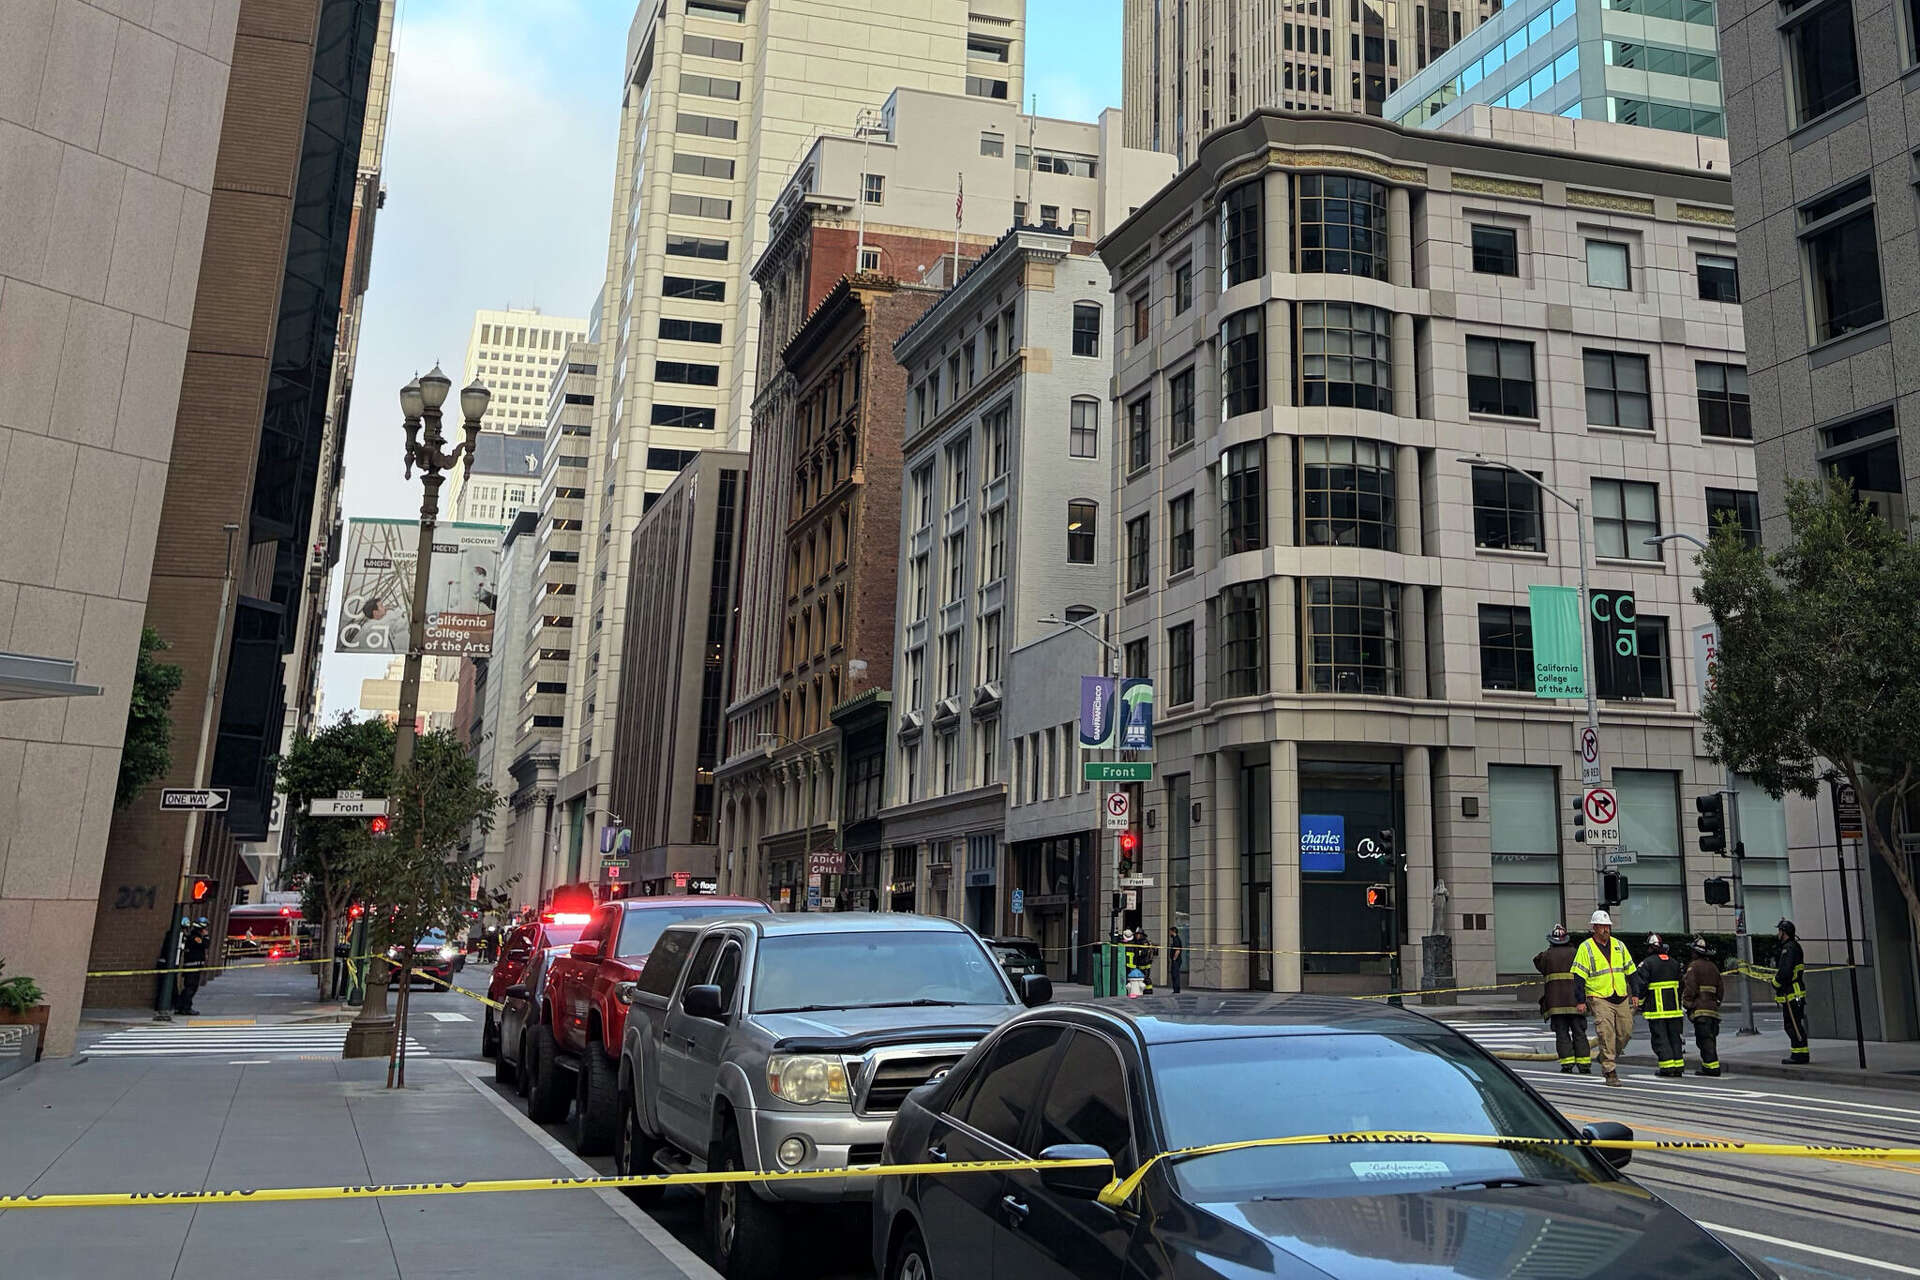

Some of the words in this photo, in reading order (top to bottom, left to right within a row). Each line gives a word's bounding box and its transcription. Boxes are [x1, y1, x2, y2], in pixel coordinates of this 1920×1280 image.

[461, 537, 496, 545] DISCOVERY
[432, 544, 457, 552] MEETS
[427, 615, 488, 627] California
[426, 627, 470, 641] College
[425, 641, 437, 650] of
[441, 641, 461, 651] the
[463, 641, 490, 652] Arts
[1536, 664, 1578, 673] California
[1537, 674, 1568, 684] College
[1538, 685, 1547, 693] of
[1565, 686, 1583, 694] Arts
[1102, 767, 1135, 777] Front
[1583, 769, 1590, 778] ON
[1590, 768, 1600, 777] RED
[167, 795, 187, 804] ONE
[189, 795, 209, 804] WAY
[333, 803, 363, 812] Front
[1117, 818, 1128, 826] RED
[1301, 830, 1340, 844] charles
[1587, 830, 1599, 839] ON
[1601, 829, 1617, 839] RED
[808, 855, 843, 865] TADICH
[811, 865, 838, 874] GRILL
